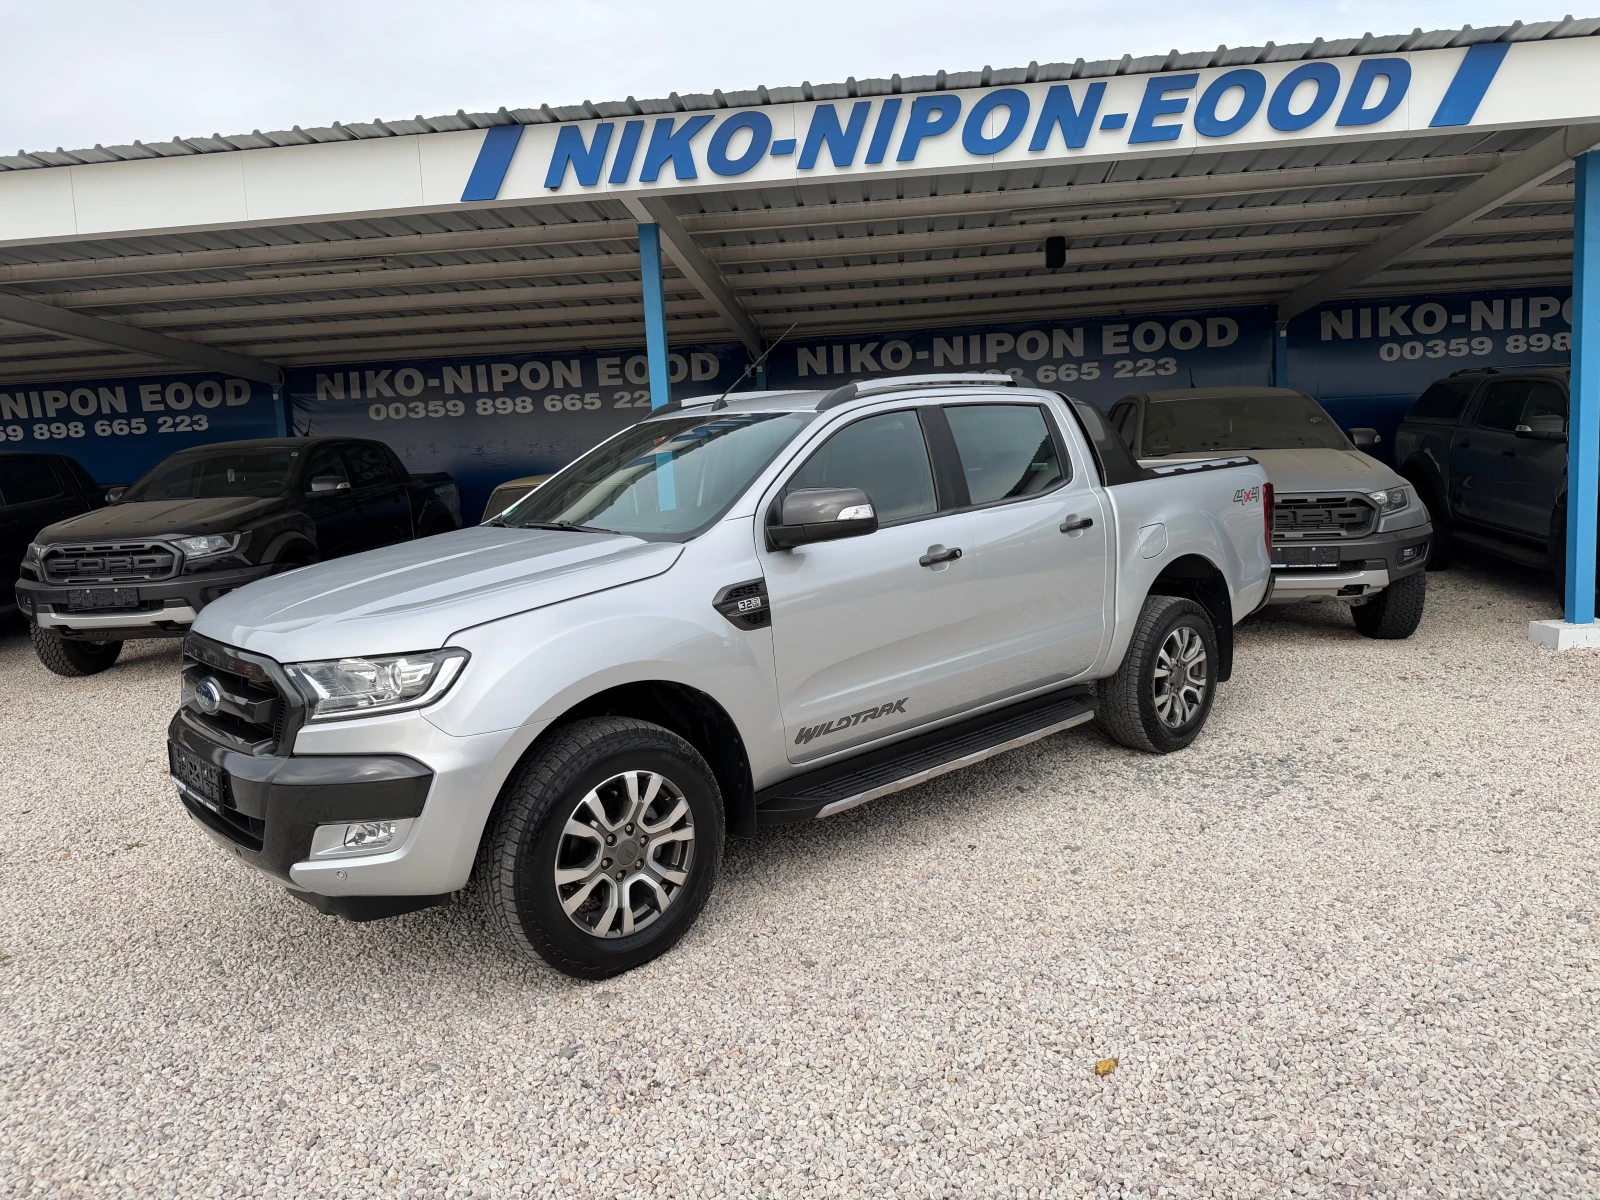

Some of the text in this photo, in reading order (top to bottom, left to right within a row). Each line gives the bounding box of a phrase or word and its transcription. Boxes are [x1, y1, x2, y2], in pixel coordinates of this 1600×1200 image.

[544, 57, 1412, 189] NIKO-NIPON-EOOD
[1320, 296, 1572, 341] NIKO-NIP
[797, 316, 1239, 377] NIKO-NIPON EOOD
[1379, 331, 1573, 362] 00359 898
[315, 352, 720, 401] NIKO-NIPON EOOD
[1036, 361, 1101, 384] 665
[1113, 357, 1178, 379] 223
[139, 378, 252, 412] EOOD
[368, 390, 652, 421] 00359 898 665 22
[32, 421, 86, 440] 898
[94, 417, 148, 437] 665
[157, 414, 209, 433] 223
[794, 696, 910, 745] WILDTRAK
